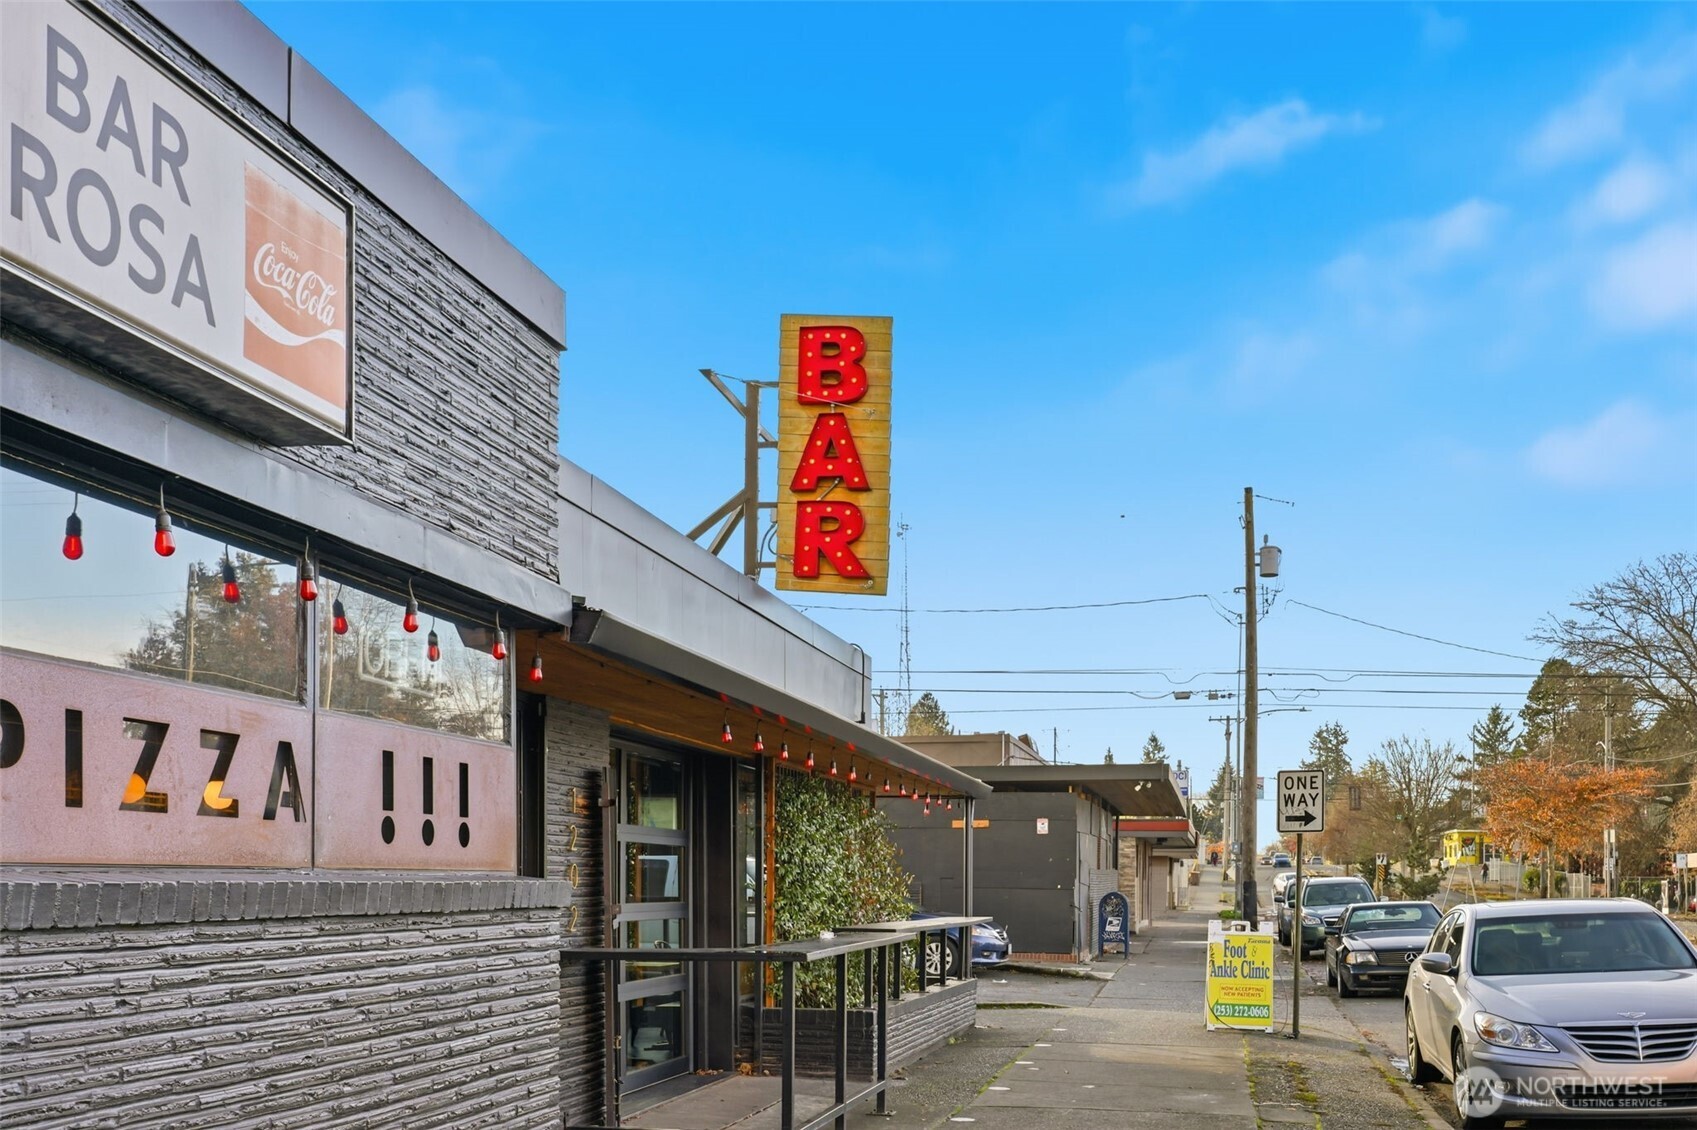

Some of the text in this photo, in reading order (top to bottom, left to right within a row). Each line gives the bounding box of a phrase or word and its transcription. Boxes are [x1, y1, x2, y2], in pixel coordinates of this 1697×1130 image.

[46, 23, 192, 208] BAR
[10, 121, 217, 329] ROSA
[789, 325, 873, 580] BAR
[380, 749, 471, 849] !!!
[1283, 792, 1319, 807] WAY
[1284, 775, 1319, 790] ONE
[566, 786, 579, 932] 1202
[1210, 960, 1270, 979] Ankle Clinic
[1223, 939, 1247, 958] Foot
[1214, 1005, 1269, 1017] (253) 272-0606
